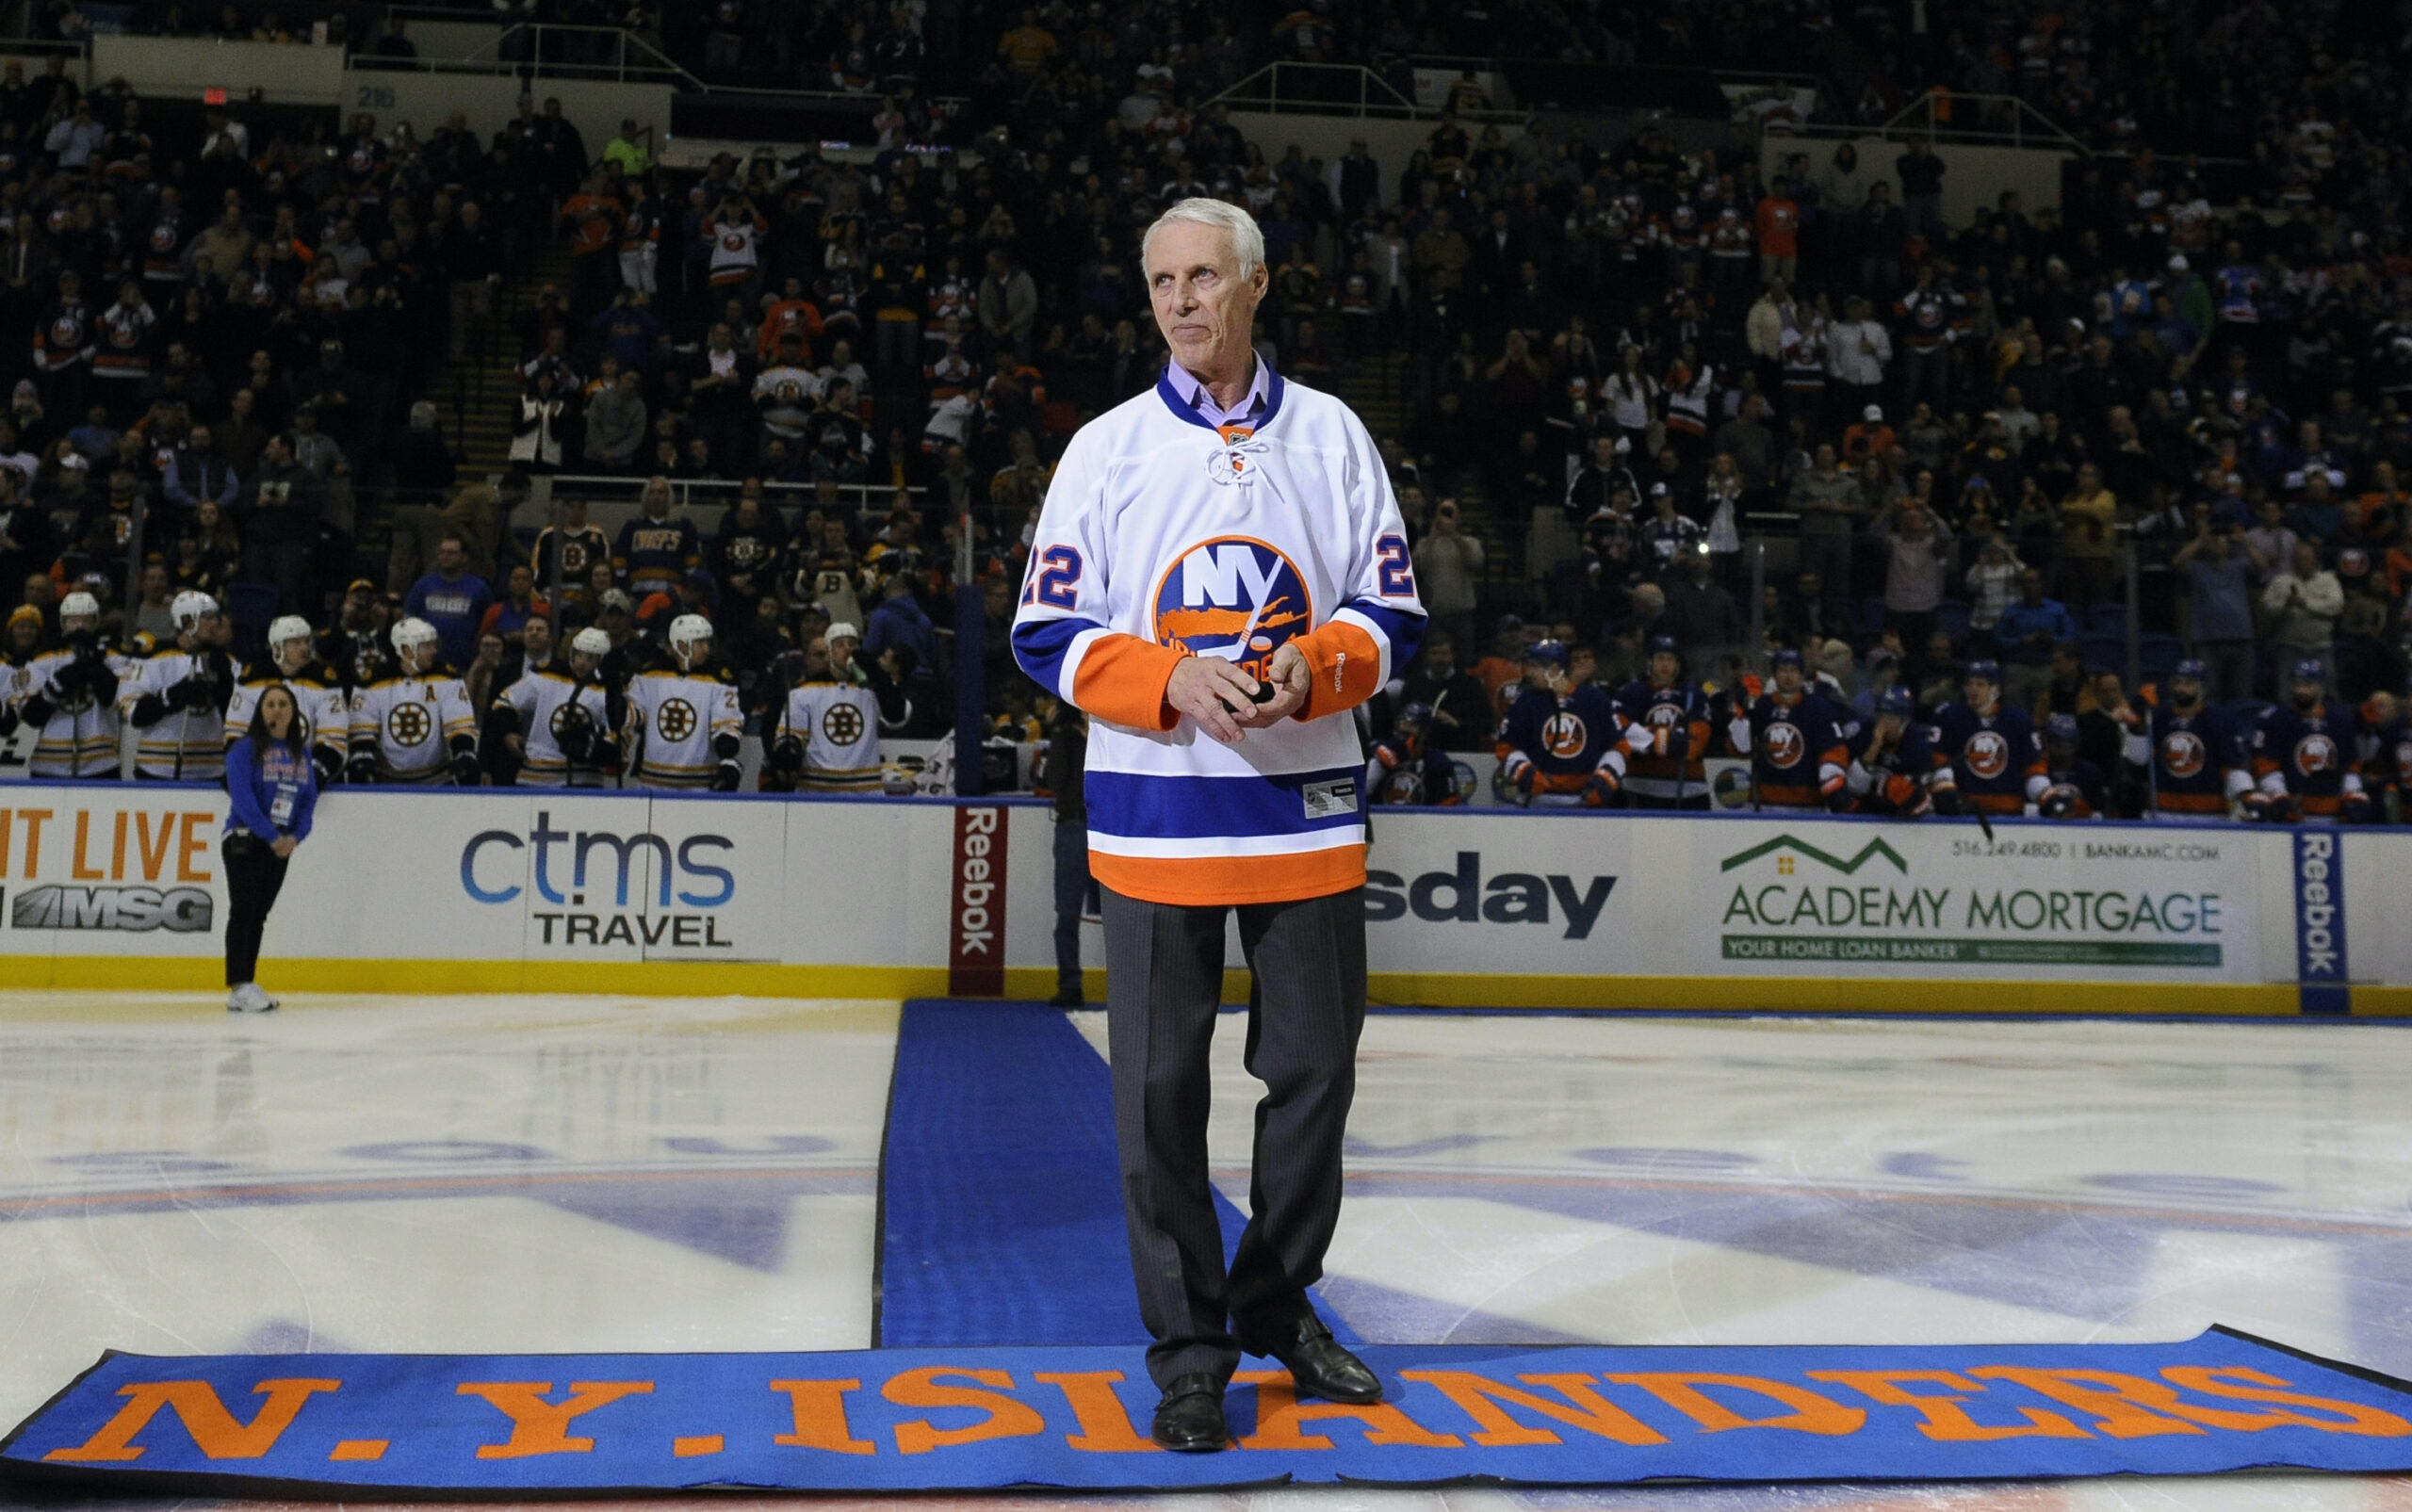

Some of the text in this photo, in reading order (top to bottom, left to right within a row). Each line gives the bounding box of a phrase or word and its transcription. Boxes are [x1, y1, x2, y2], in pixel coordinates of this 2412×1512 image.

[824, 575, 841, 594] B
[1183, 545, 1284, 626] NY
[425, 685, 436, 702] A
[399, 715, 420, 737] B
[668, 707, 687, 732] B
[835, 712, 853, 735] B
[73, 810, 215, 883] LIVE
[460, 811, 735, 908] ctms
[2085, 842, 2222, 862] BANKAMC.COM
[962, 807, 997, 955] Reebok
[58, 886, 213, 933] MSG
[1721, 884, 2223, 934] ACADEMY MORTGAGE
[2302, 833, 2339, 973] Reebok
[533, 913, 733, 947] TRAVEL
[1727, 939, 1776, 957] YOUR
[1781, 940, 1833, 958] HOME
[1838, 941, 1885, 958] LOAN
[1891, 942, 1959, 959] BANKER
